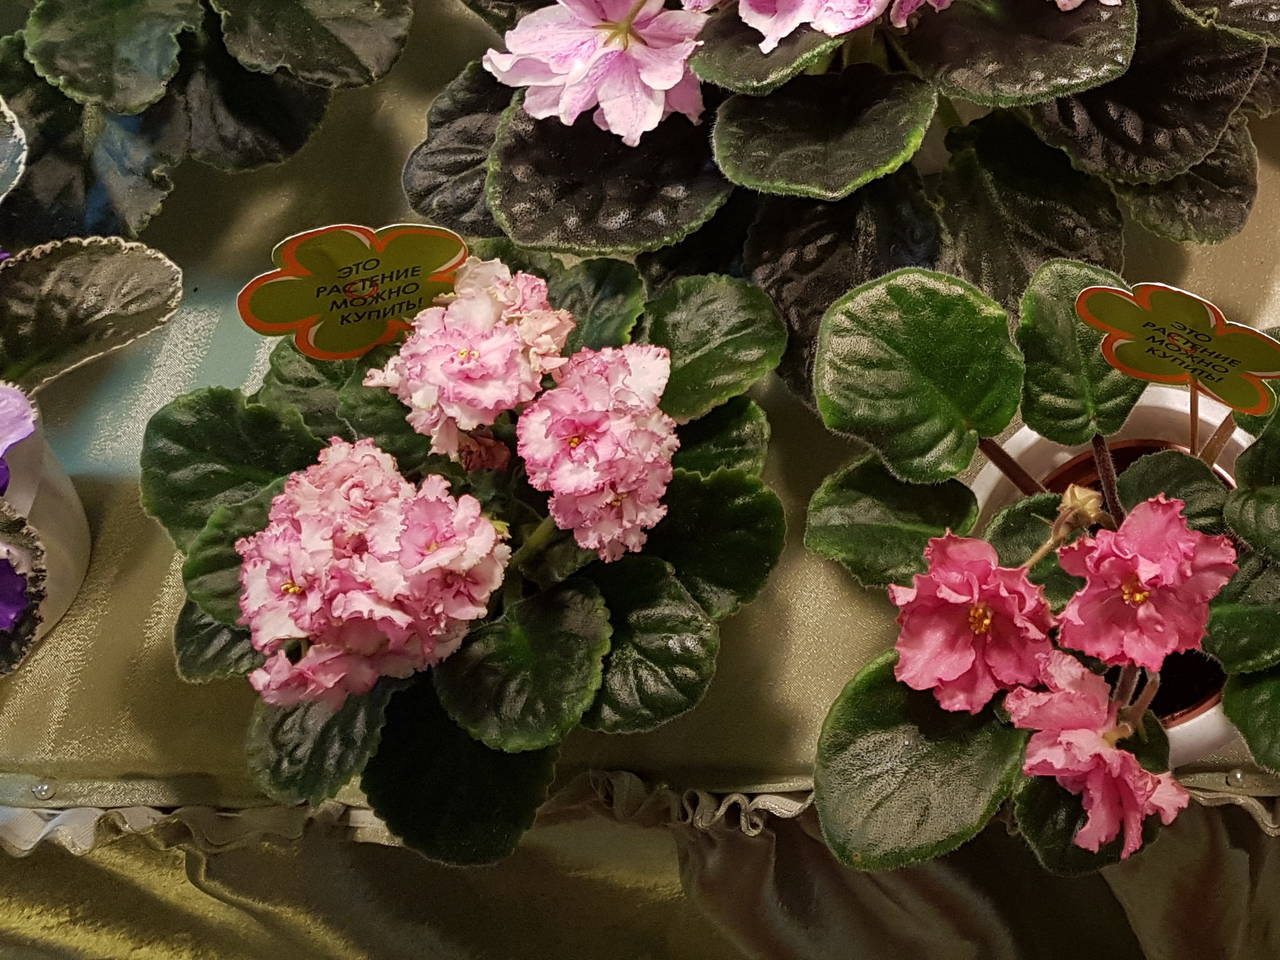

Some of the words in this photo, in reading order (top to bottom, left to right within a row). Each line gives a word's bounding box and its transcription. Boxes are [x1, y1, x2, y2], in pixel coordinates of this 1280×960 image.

[315, 266, 422, 298] РАСТЕНИЕ
[336, 258, 381, 279] ЭТО
[329, 282, 420, 313] МОЖНО
[340, 297, 424, 326] КУПИТЬ!
[1141, 321, 1242, 368] РАСТЕНИЕ
[1170, 321, 1212, 343] ЭТО
[1145, 335, 1230, 374] МОЖНО
